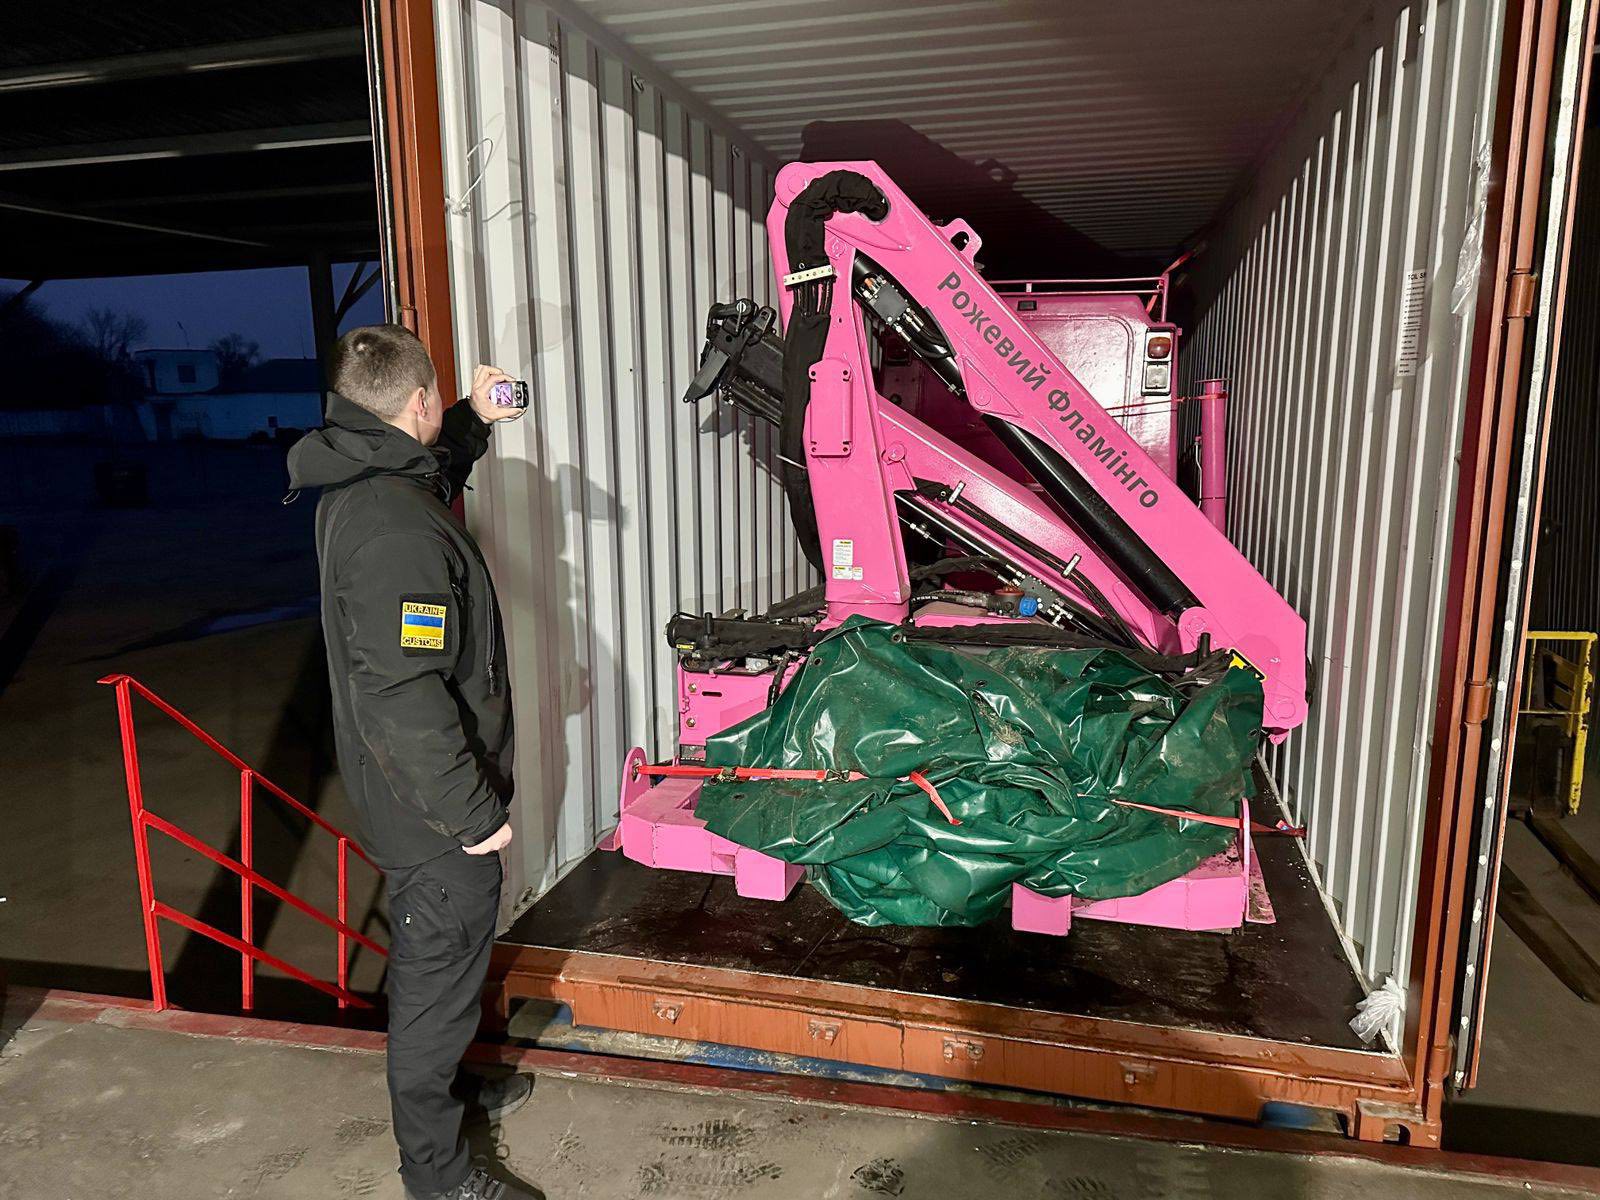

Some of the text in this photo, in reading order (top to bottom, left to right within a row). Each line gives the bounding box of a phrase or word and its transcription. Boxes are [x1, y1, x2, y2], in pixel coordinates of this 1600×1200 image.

[937, 271, 1159, 508] Рожевий Фламінго
[404, 604, 444, 615] UKRAINE
[402, 636, 442, 647] CUSTOMS
